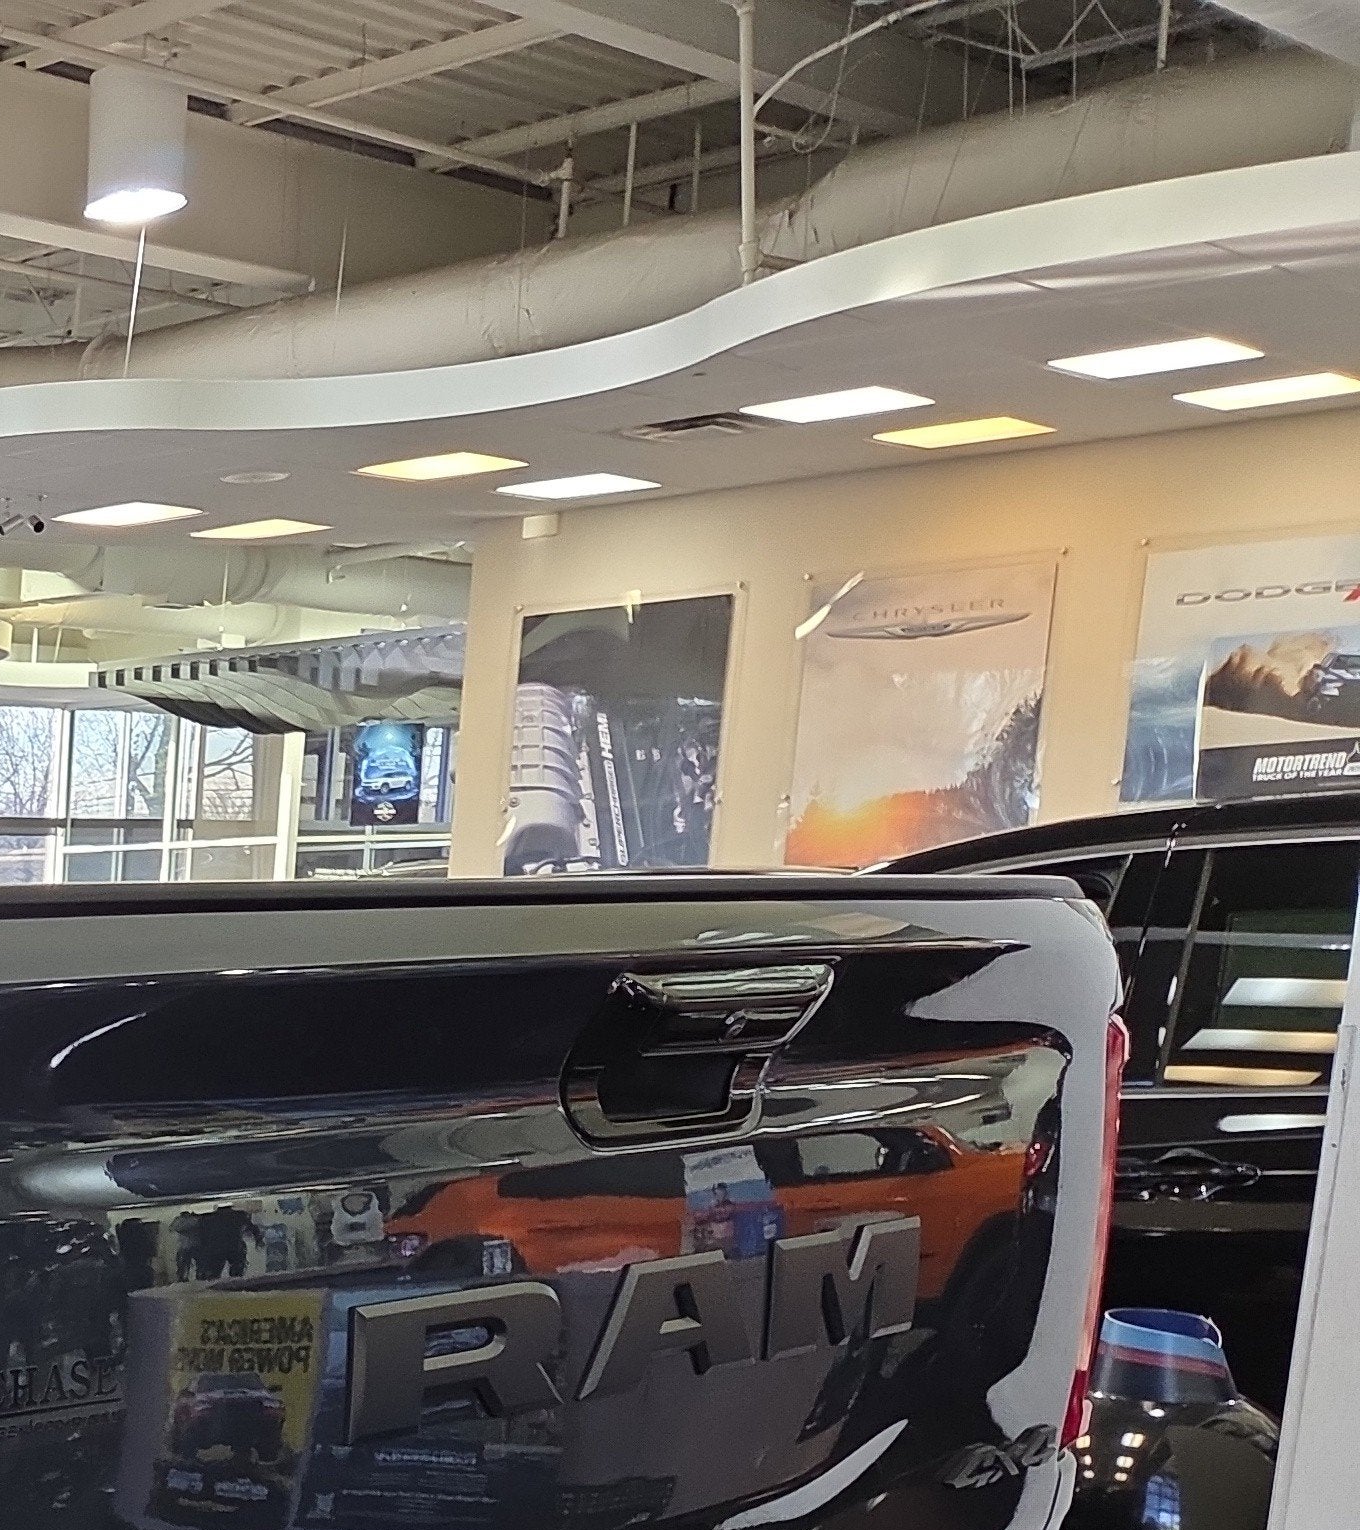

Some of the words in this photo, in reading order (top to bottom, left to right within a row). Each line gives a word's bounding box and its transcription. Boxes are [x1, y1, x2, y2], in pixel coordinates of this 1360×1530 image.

[1175, 579, 1360, 605] DODGE
[853, 598, 1005, 621] CHRYSLER
[596, 712, 614, 759] HEMI
[1253, 751, 1347, 774] MOTORTREND
[1252, 772, 1282, 782] TRUCK
[1283, 771, 1298, 780] OF
[1300, 770, 1316, 778] THE
[1318, 768, 1342, 777] YEAR
[345, 1216, 921, 1447] RAM
